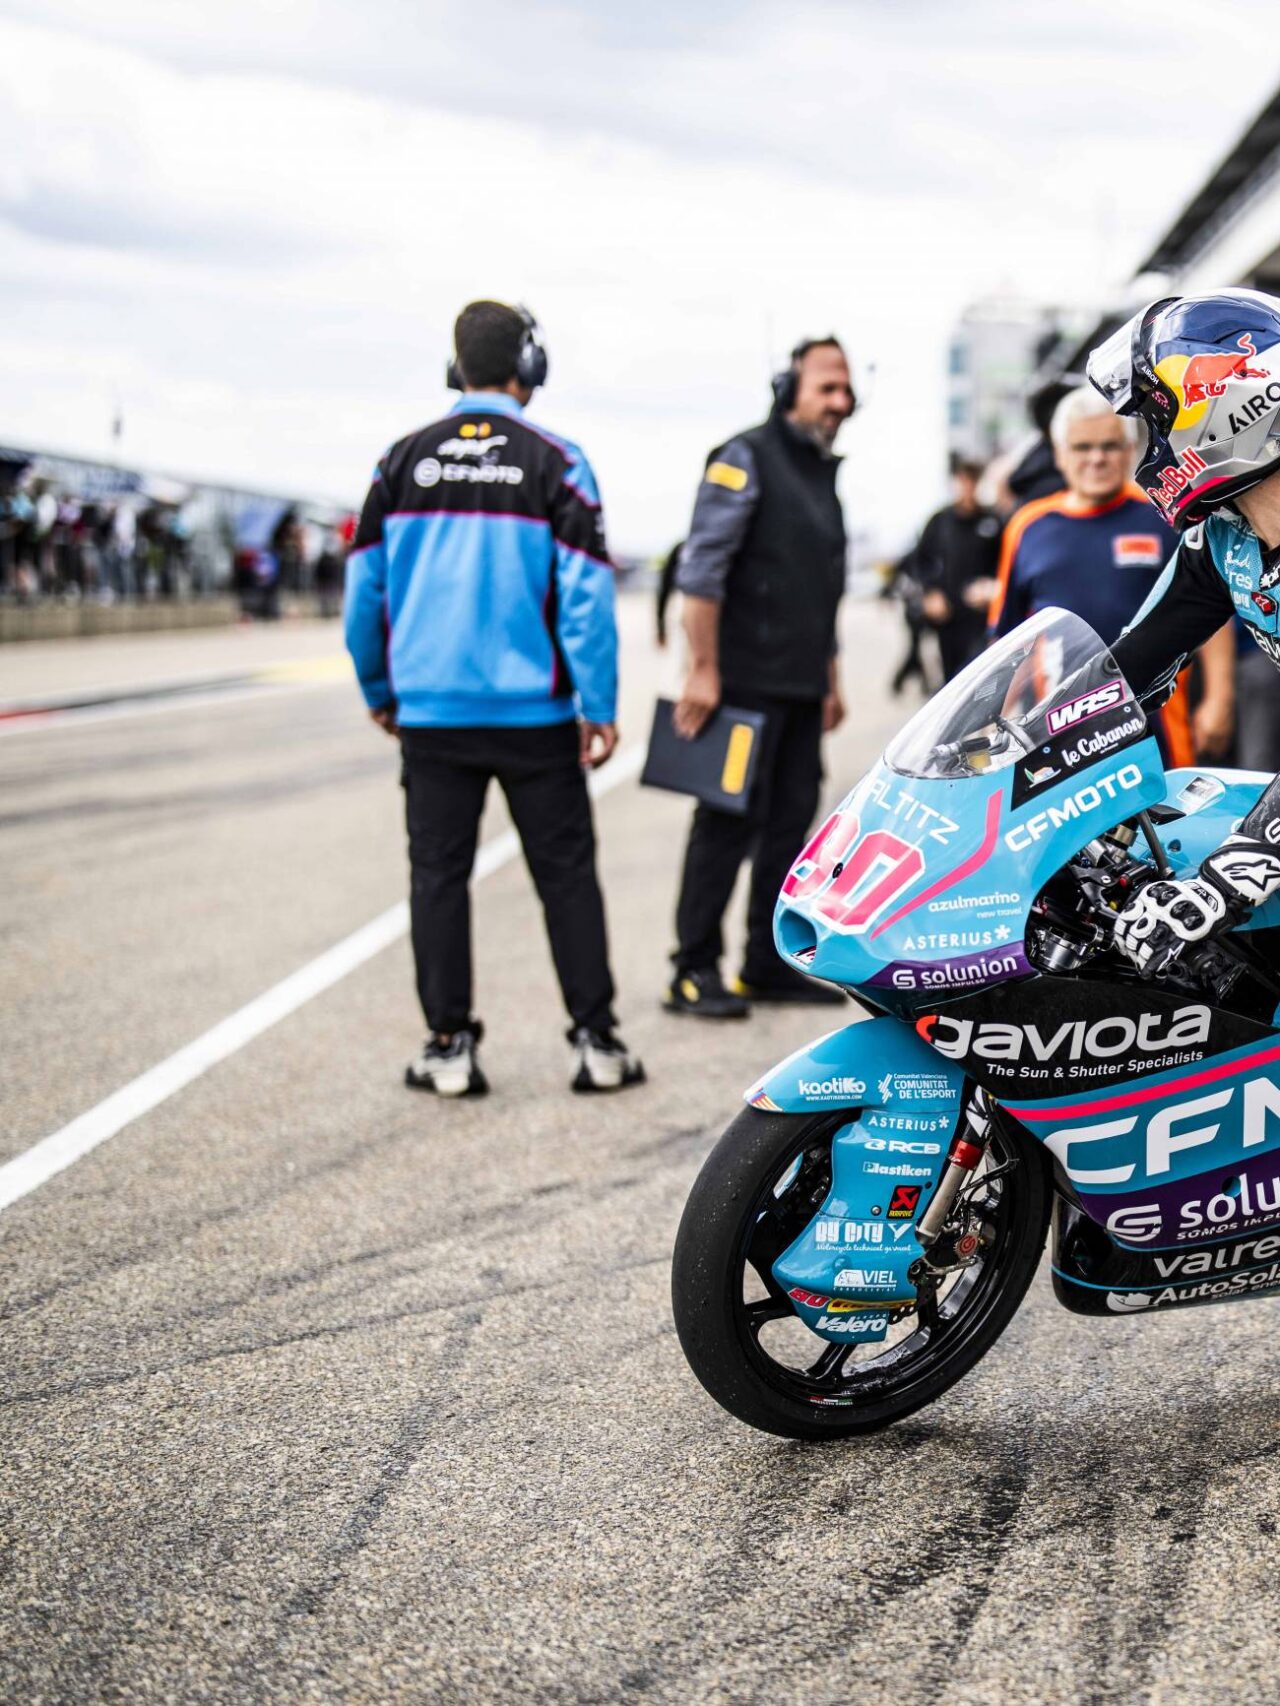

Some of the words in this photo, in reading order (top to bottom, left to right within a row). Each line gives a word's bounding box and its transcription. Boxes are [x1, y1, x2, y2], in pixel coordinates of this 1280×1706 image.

[1141, 366, 1159, 385] AIROH
[1050, 683, 1121, 731] WRS
[1061, 749, 1080, 766] le
[1077, 718, 1143, 756] Cabanon
[1004, 764, 1142, 852] CFMOTO
[928, 892, 1020, 912] azulmarino
[903, 931, 992, 951] ASTERIUS
[921, 956, 1017, 985] solunion
[916, 1004, 1211, 1061] gaviota
[987, 1064, 1014, 1077] The
[1020, 1067, 1048, 1078] Sun
[1053, 1067, 1064, 1078] &
[1069, 1062, 1124, 1077] Shutter
[1127, 1052, 1203, 1072] Specialists
[894, 1080, 948, 1089] COMUNITAT
[900, 1090, 912, 1099] DE
[914, 1089, 956, 1099] L'ESPORT
[868, 1116, 936, 1132] ASTERIUS
[888, 1140, 941, 1155] RCB
[863, 1161, 932, 1176] Plastiken
[1176, 1223, 1238, 1240] SOMOS
[864, 1270, 897, 1284] VIEL
[1211, 1286, 1245, 1299] solar
[815, 1315, 887, 1332] Valero
